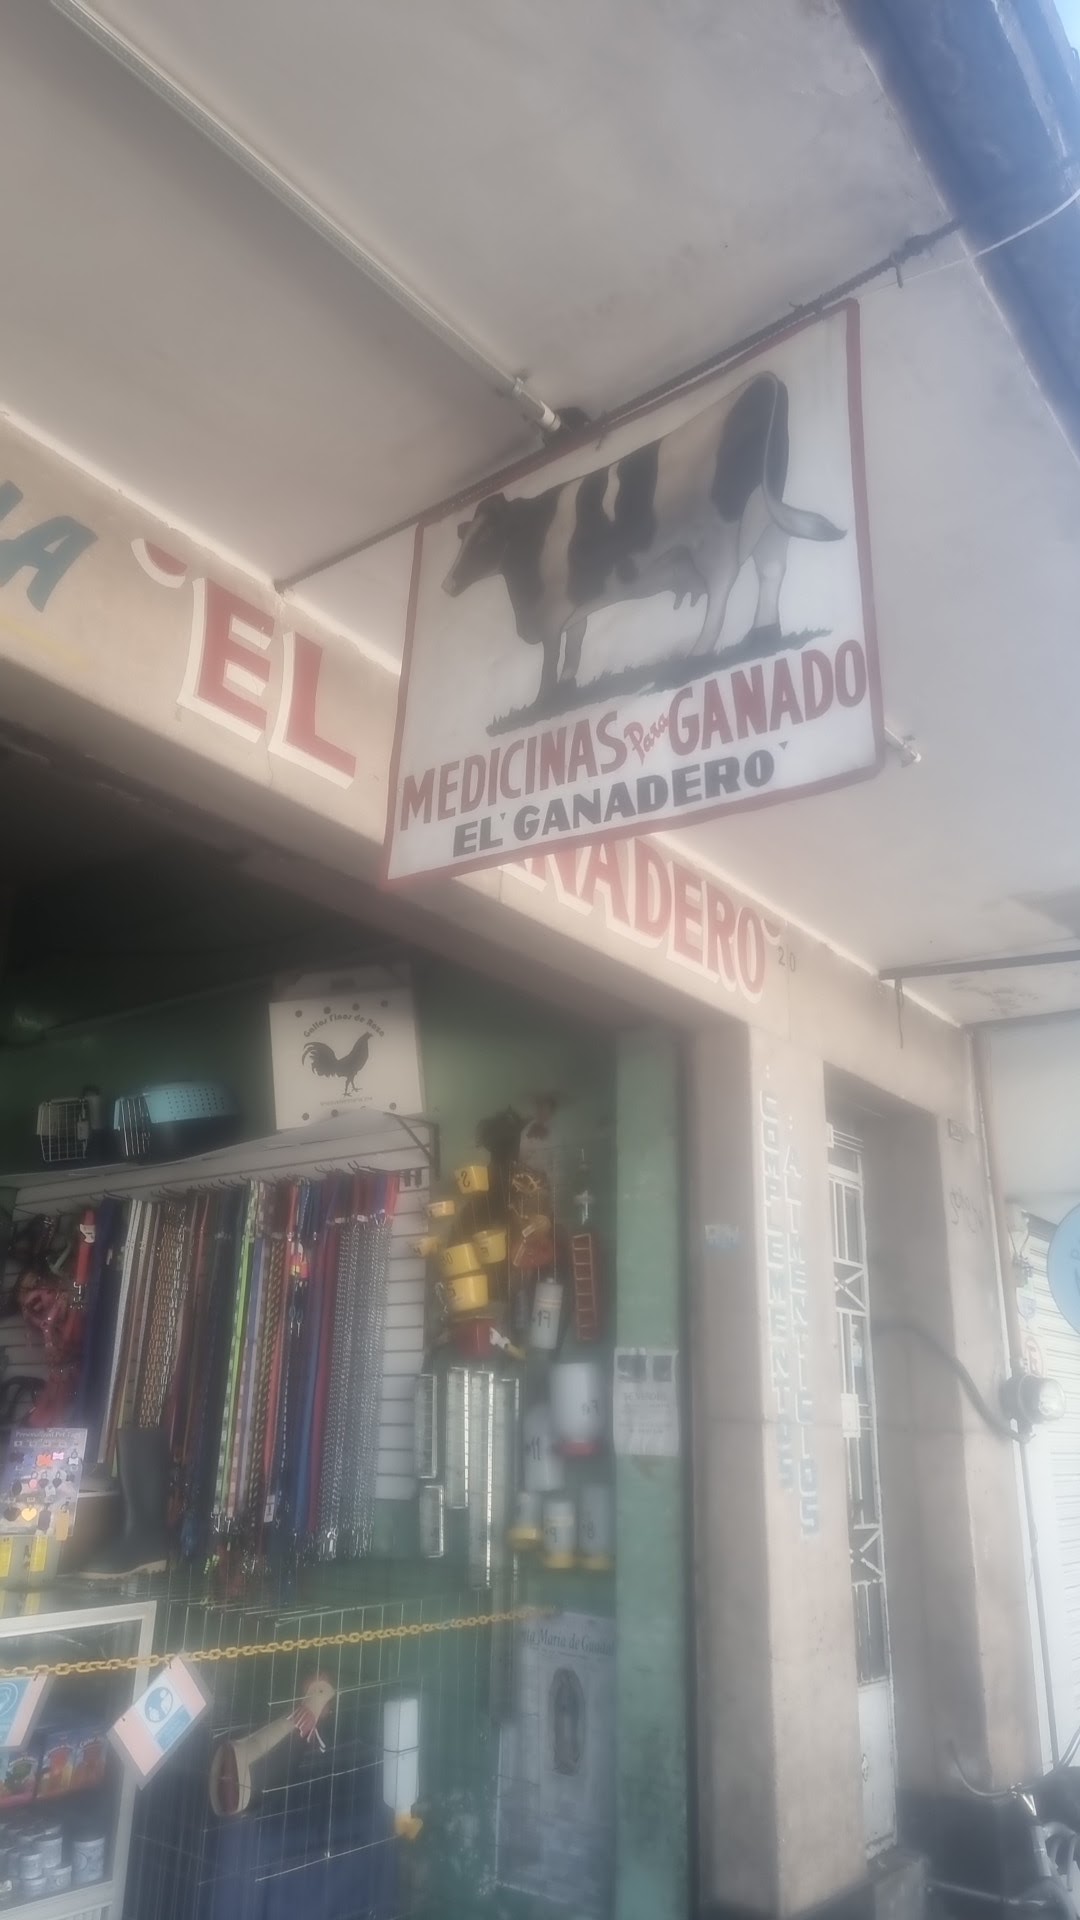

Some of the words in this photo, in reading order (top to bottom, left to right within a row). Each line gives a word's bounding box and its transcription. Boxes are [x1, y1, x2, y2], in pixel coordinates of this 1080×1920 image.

[177, 576, 357, 789] EL
[400, 711, 628, 832] MEDICINAS
[623, 713, 670, 765] Para
[668, 639, 867, 757] GANADO
[452, 816, 504, 858] EL
[512, 749, 776, 841] GANADERO
[777, 945, 797, 972] 20
